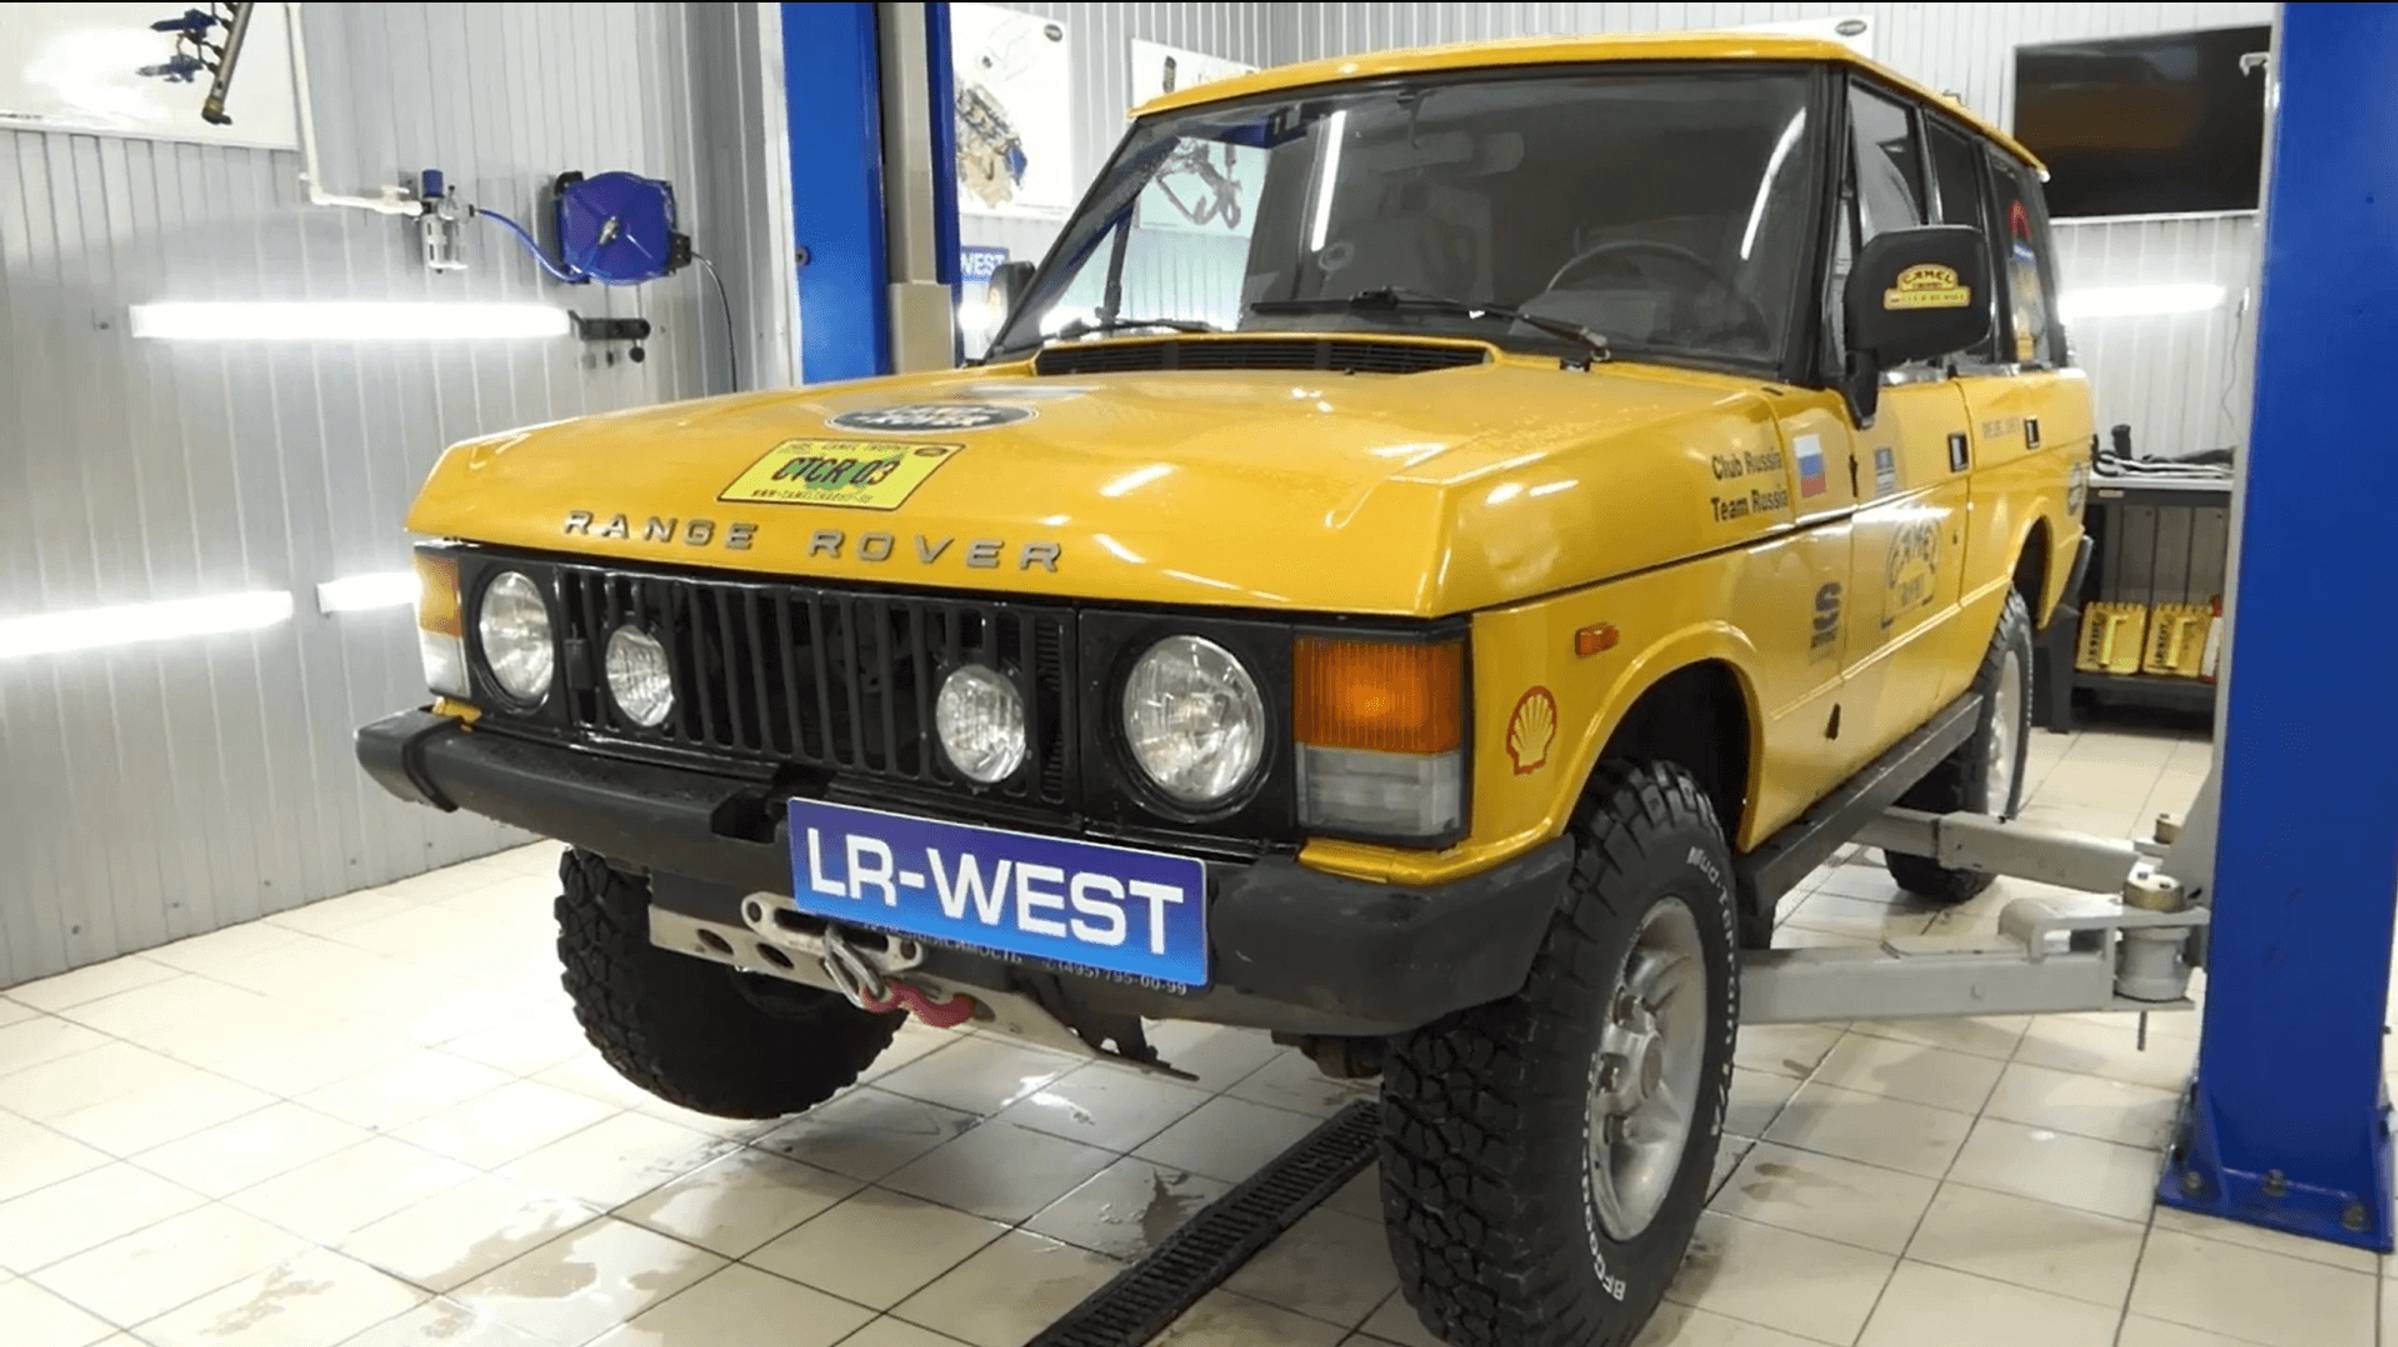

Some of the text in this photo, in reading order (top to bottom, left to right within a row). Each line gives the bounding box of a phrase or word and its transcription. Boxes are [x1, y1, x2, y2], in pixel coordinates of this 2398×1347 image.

[1902, 269, 1953, 284] CAMEL
[771, 456, 901, 485] CTCR 03
[1711, 446, 1783, 480] Club Russia
[1710, 483, 1790, 522] Team Russia
[564, 509, 1062, 574] RANGE ROVER
[806, 827, 1185, 956] LR-WEST
